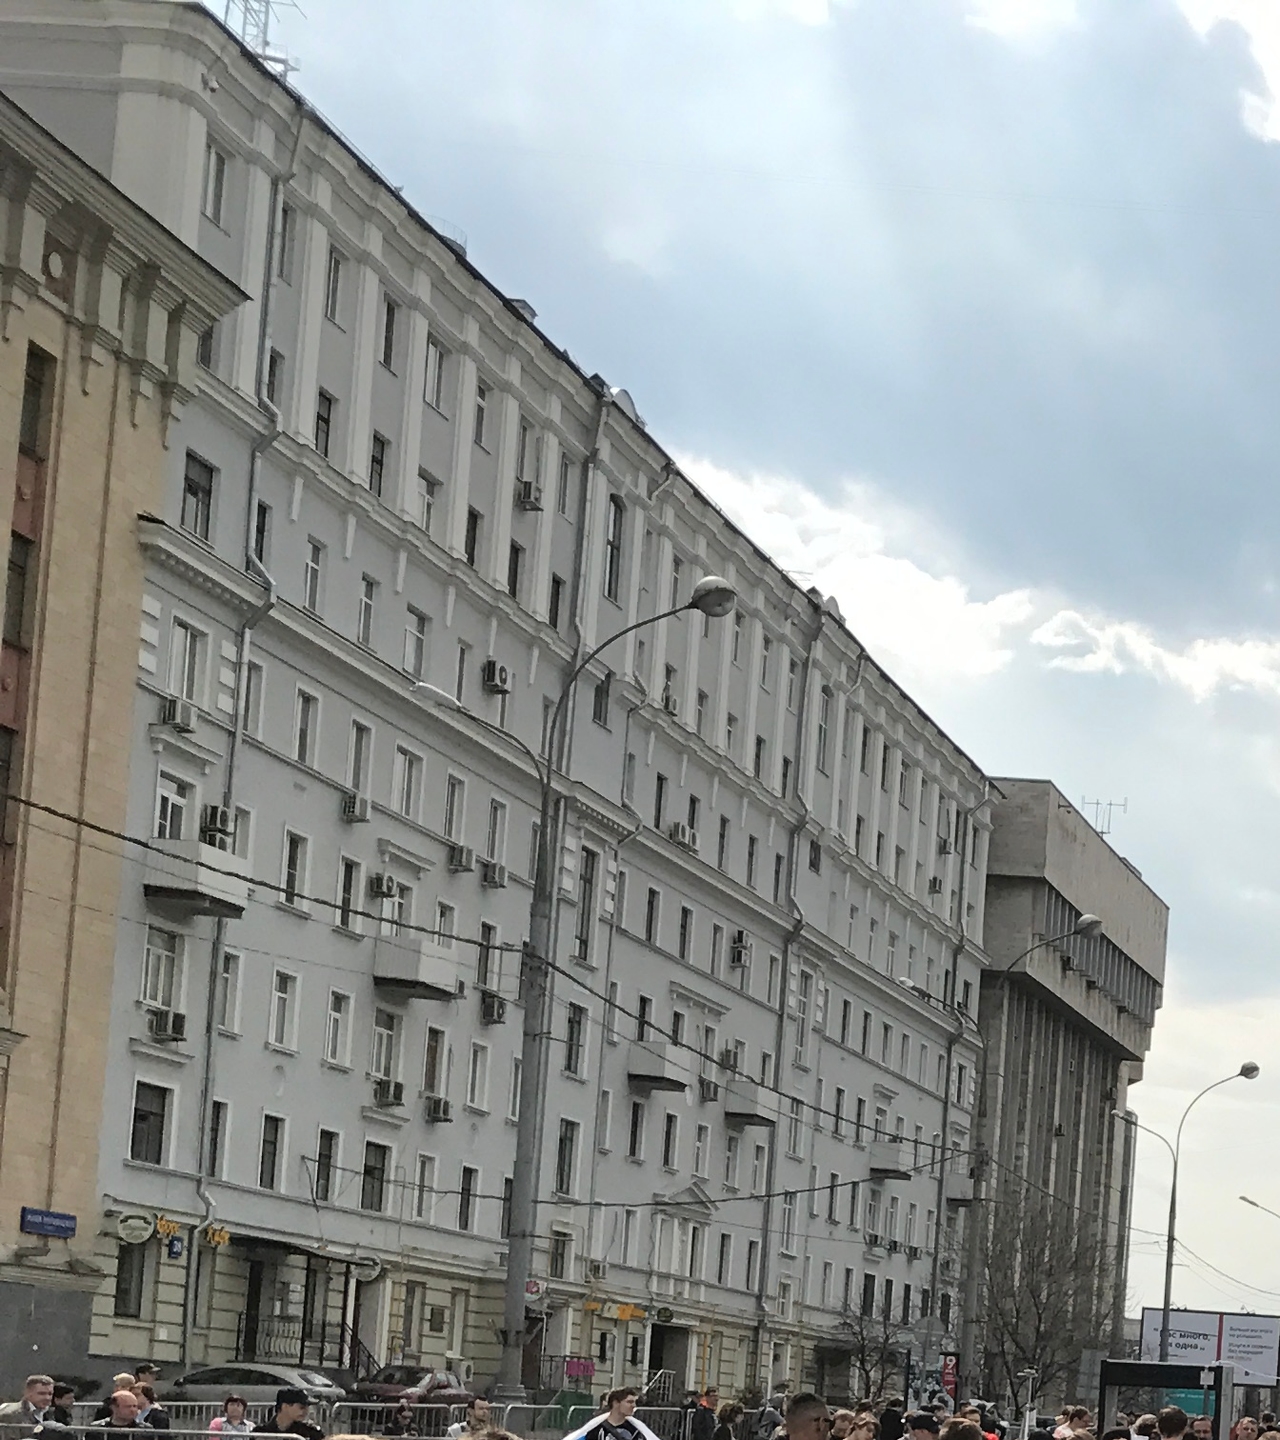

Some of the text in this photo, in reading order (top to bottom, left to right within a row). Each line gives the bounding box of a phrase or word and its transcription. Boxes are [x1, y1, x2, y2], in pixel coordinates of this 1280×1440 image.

[1179, 1332, 1211, 1341] много,
[1175, 1342, 1199, 1350] одна
[946, 1356, 956, 1369] 9
